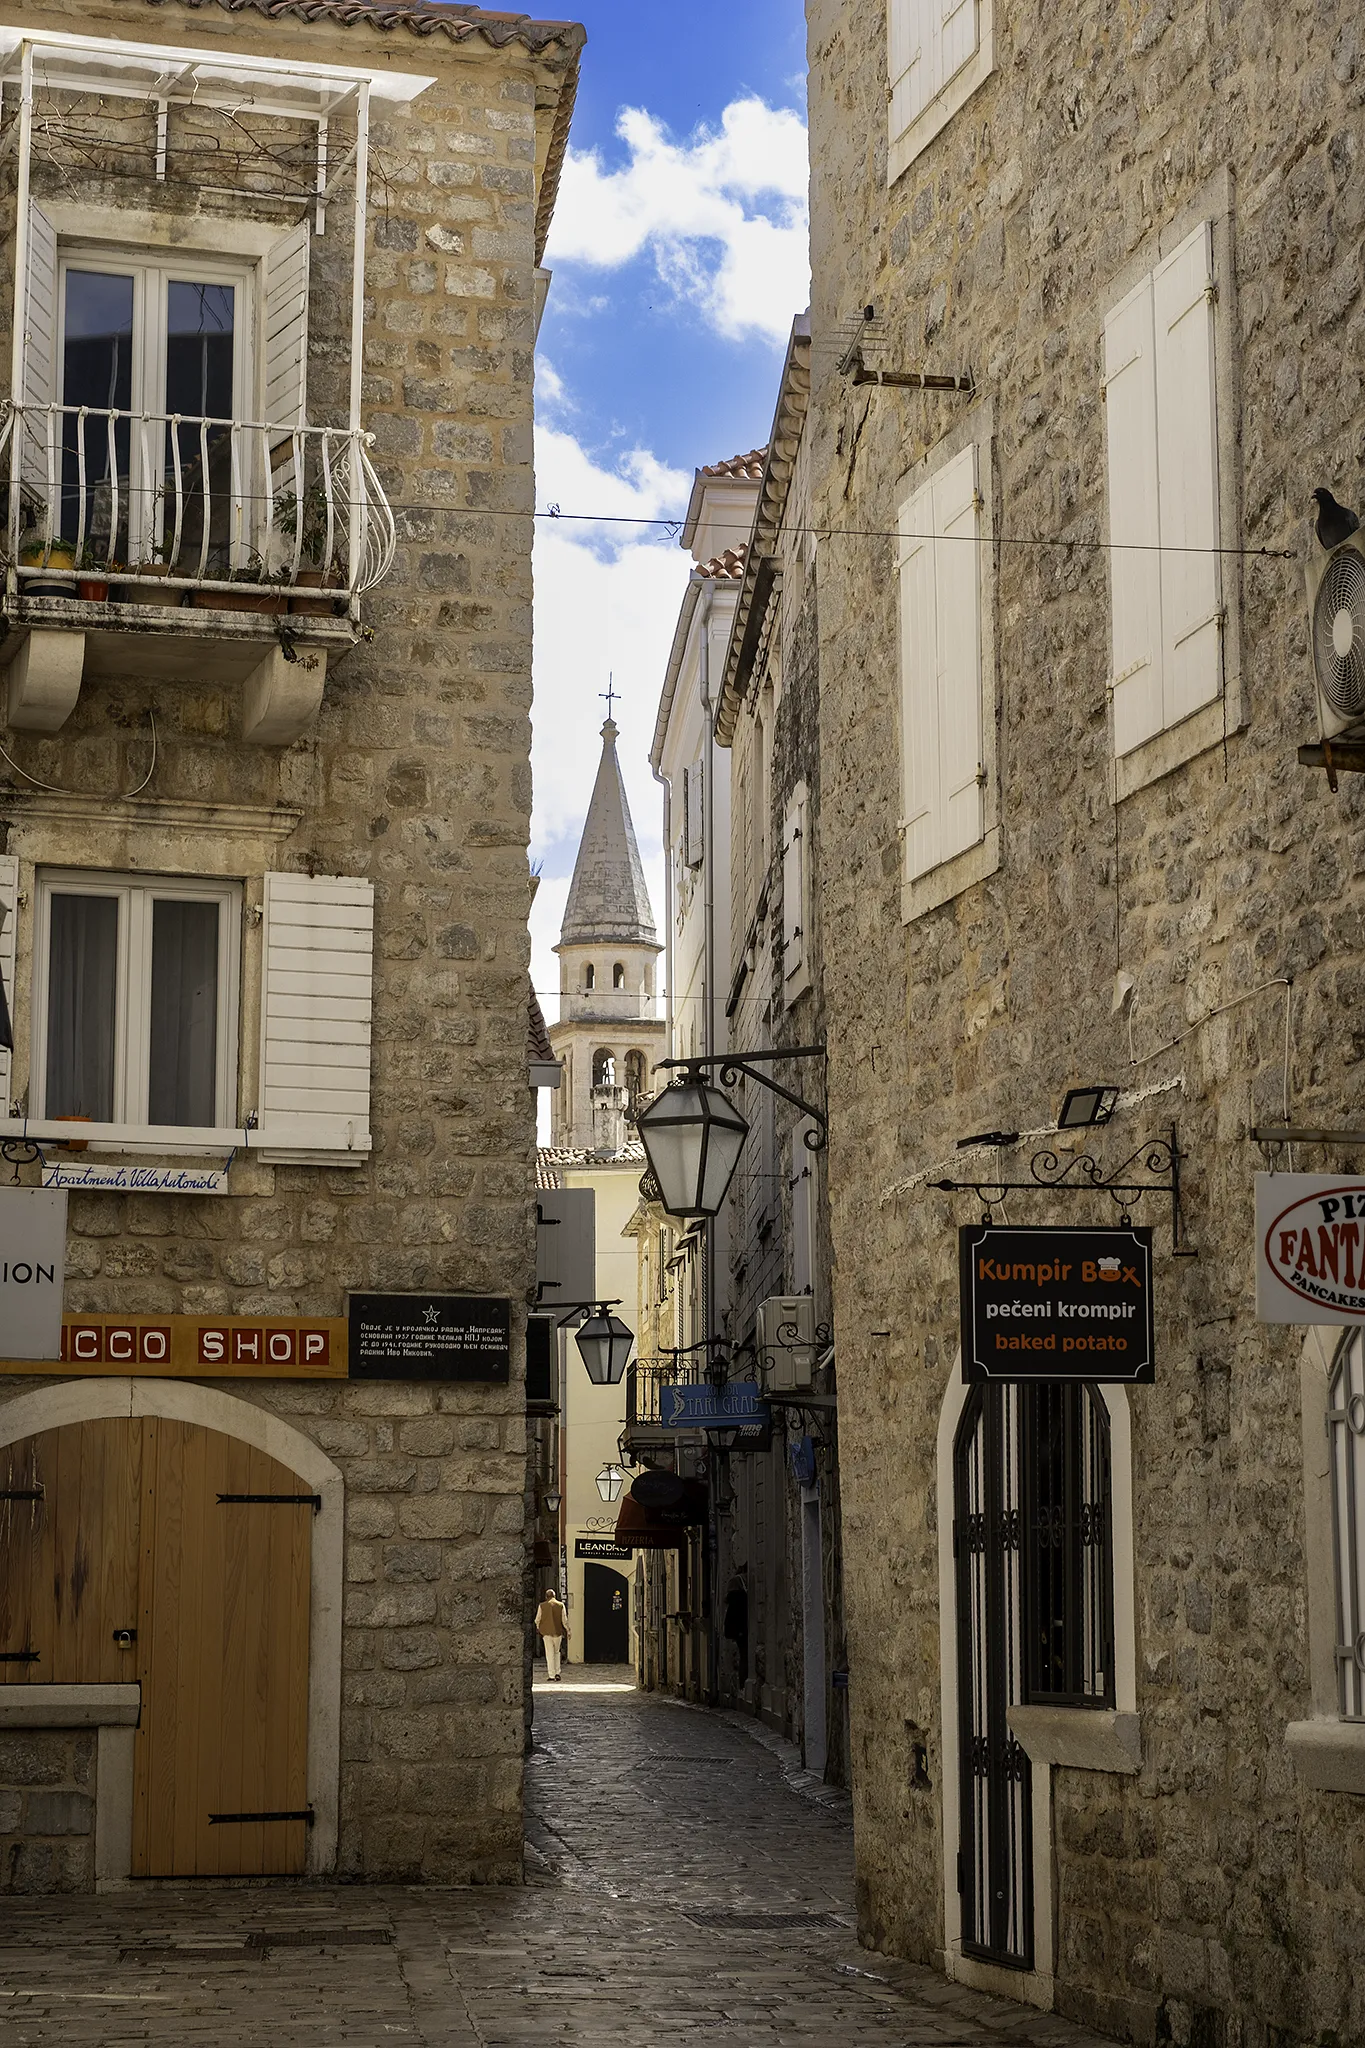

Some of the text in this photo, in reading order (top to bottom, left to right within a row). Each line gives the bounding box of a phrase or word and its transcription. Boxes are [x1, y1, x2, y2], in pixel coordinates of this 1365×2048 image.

[44, 1163, 127, 1188] Apartments
[130, 1168, 159, 1187] Villa
[979, 1257, 1072, 1287] Kumpir
[986, 1299, 1136, 1320] pečeni krompir
[202, 1331, 326, 1362] SHOP
[995, 1333, 1128, 1352] baked potato
[722, 1395, 759, 1414] GRAD
[621, 1535, 655, 1545] PIZZERIA
